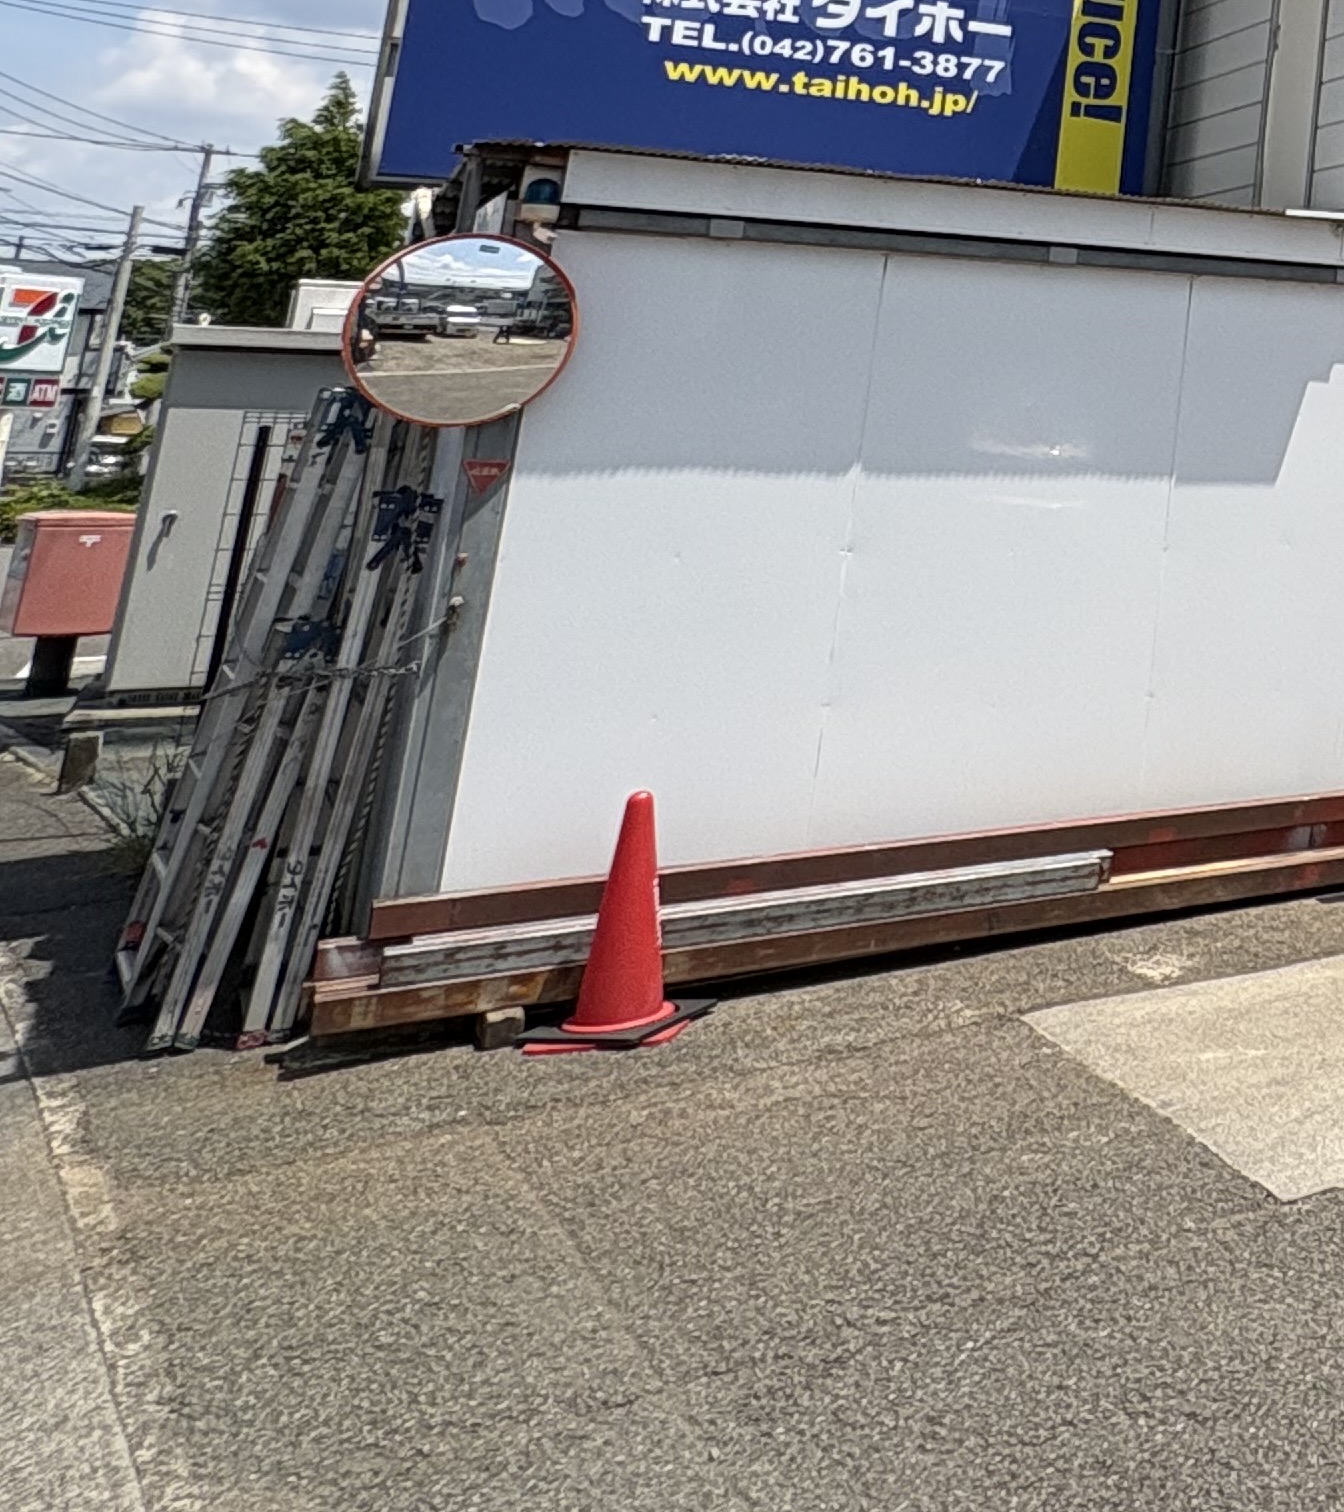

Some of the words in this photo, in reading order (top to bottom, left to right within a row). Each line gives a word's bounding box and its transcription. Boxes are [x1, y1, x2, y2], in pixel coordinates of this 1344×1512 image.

[641, 15, 1006, 84] TEL.(042)761-3877
[664, 60, 979, 115] www.taihoh.jp/
[31, 384, 59, 402] ATM
